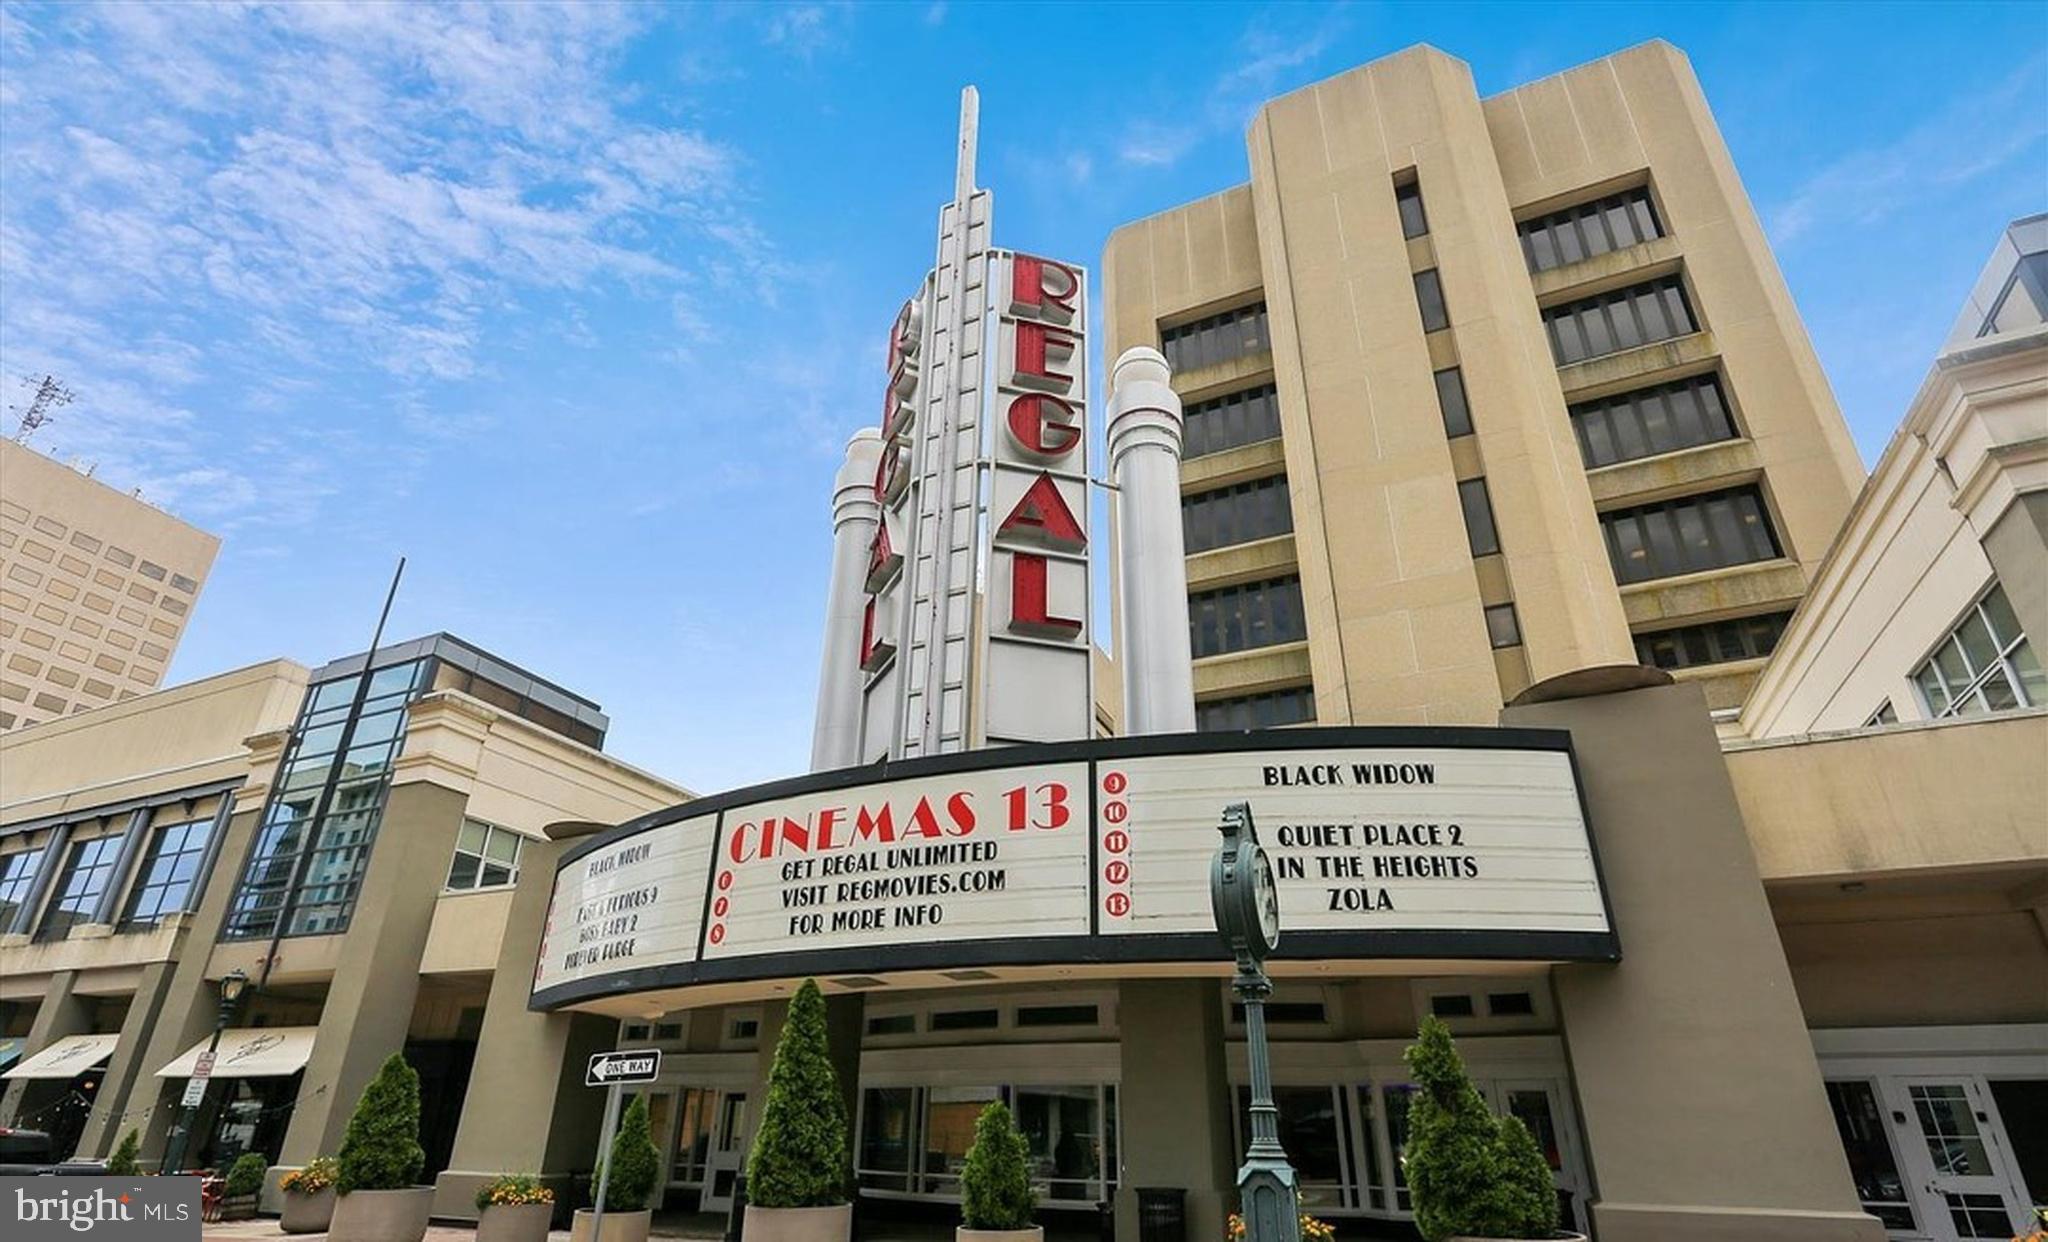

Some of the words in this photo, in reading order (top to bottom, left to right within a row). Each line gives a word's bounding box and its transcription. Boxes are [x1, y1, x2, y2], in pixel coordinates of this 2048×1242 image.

[996, 254, 1087, 638] REGAL
[1262, 765, 1344, 786] BLACK
[1351, 764, 1435, 784] WIDOW
[730, 792, 976, 864] CINEMAS
[1001, 783, 1070, 831] 13
[1106, 804, 1125, 821] 10
[1107, 833, 1126, 851] 11
[1277, 825, 1354, 848] QUIET
[1362, 824, 1443, 846] PLACE
[1447, 824, 1464, 846] 2
[781, 858, 816, 881] GET
[822, 852, 879, 876] REGAL
[887, 840, 998, 869] UNLIMITED
[1277, 857, 1305, 879] IN
[1316, 856, 1364, 877] THE
[1372, 856, 1479, 878] HEIGHTS
[1107, 863, 1127, 882] 12
[782, 885, 828, 908] VISIT
[837, 869, 1006, 902] REGMOVIES.COM
[1327, 888, 1394, 911] ZOLA
[1108, 895, 1128, 914] 13
[790, 913, 823, 935] FOR
[831, 908, 886, 932] MORE
[894, 903, 943, 927] INFO
[605, 1061, 627, 1074] ONE
[628, 1060, 652, 1072] WAY
